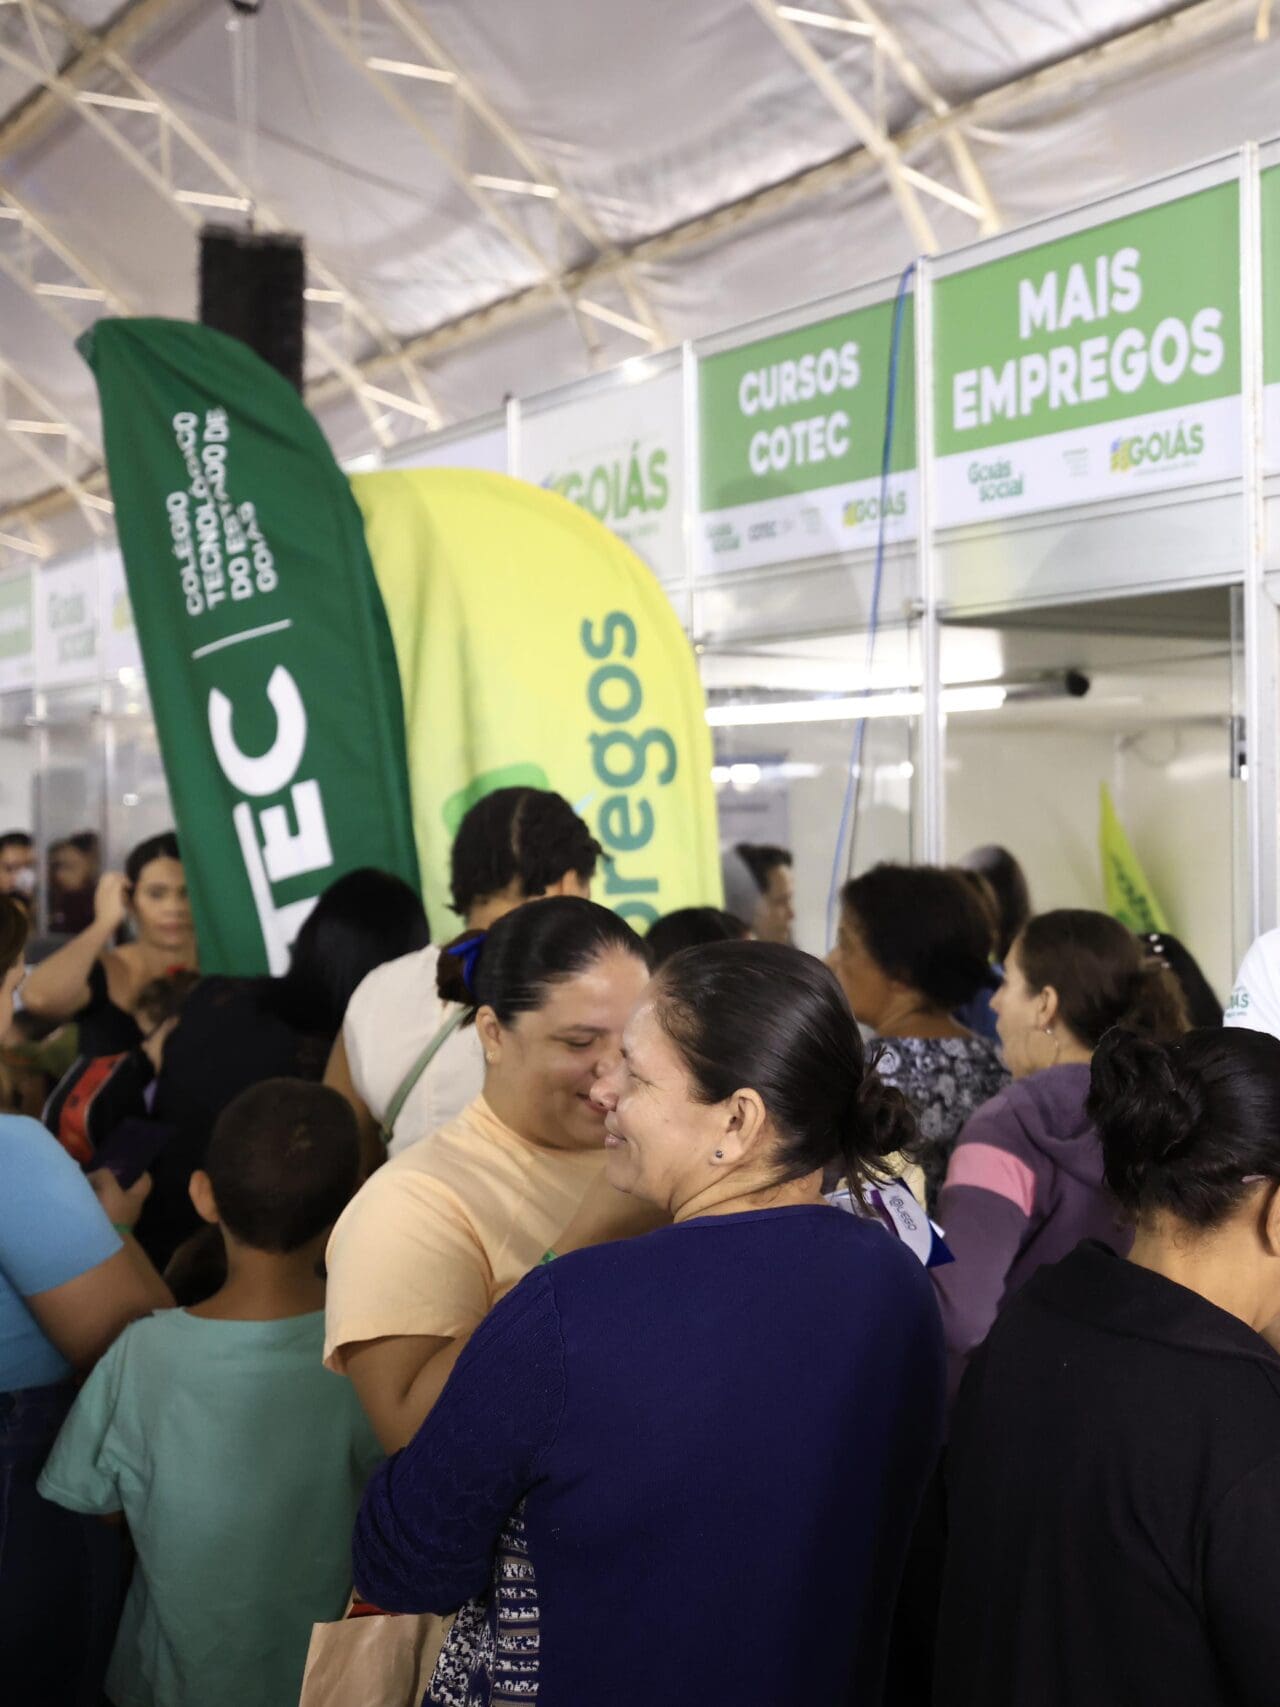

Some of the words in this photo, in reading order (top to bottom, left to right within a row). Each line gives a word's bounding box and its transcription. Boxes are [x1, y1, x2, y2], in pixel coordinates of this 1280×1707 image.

[1019, 248, 1142, 339] MAIS
[739, 341, 860, 416] CURSOS
[953, 308, 1224, 431] EMPREGOS
[749, 412, 850, 476] COTEC
[1130, 420, 1204, 465] GOIÁS
[228, 556, 254, 600] DO
